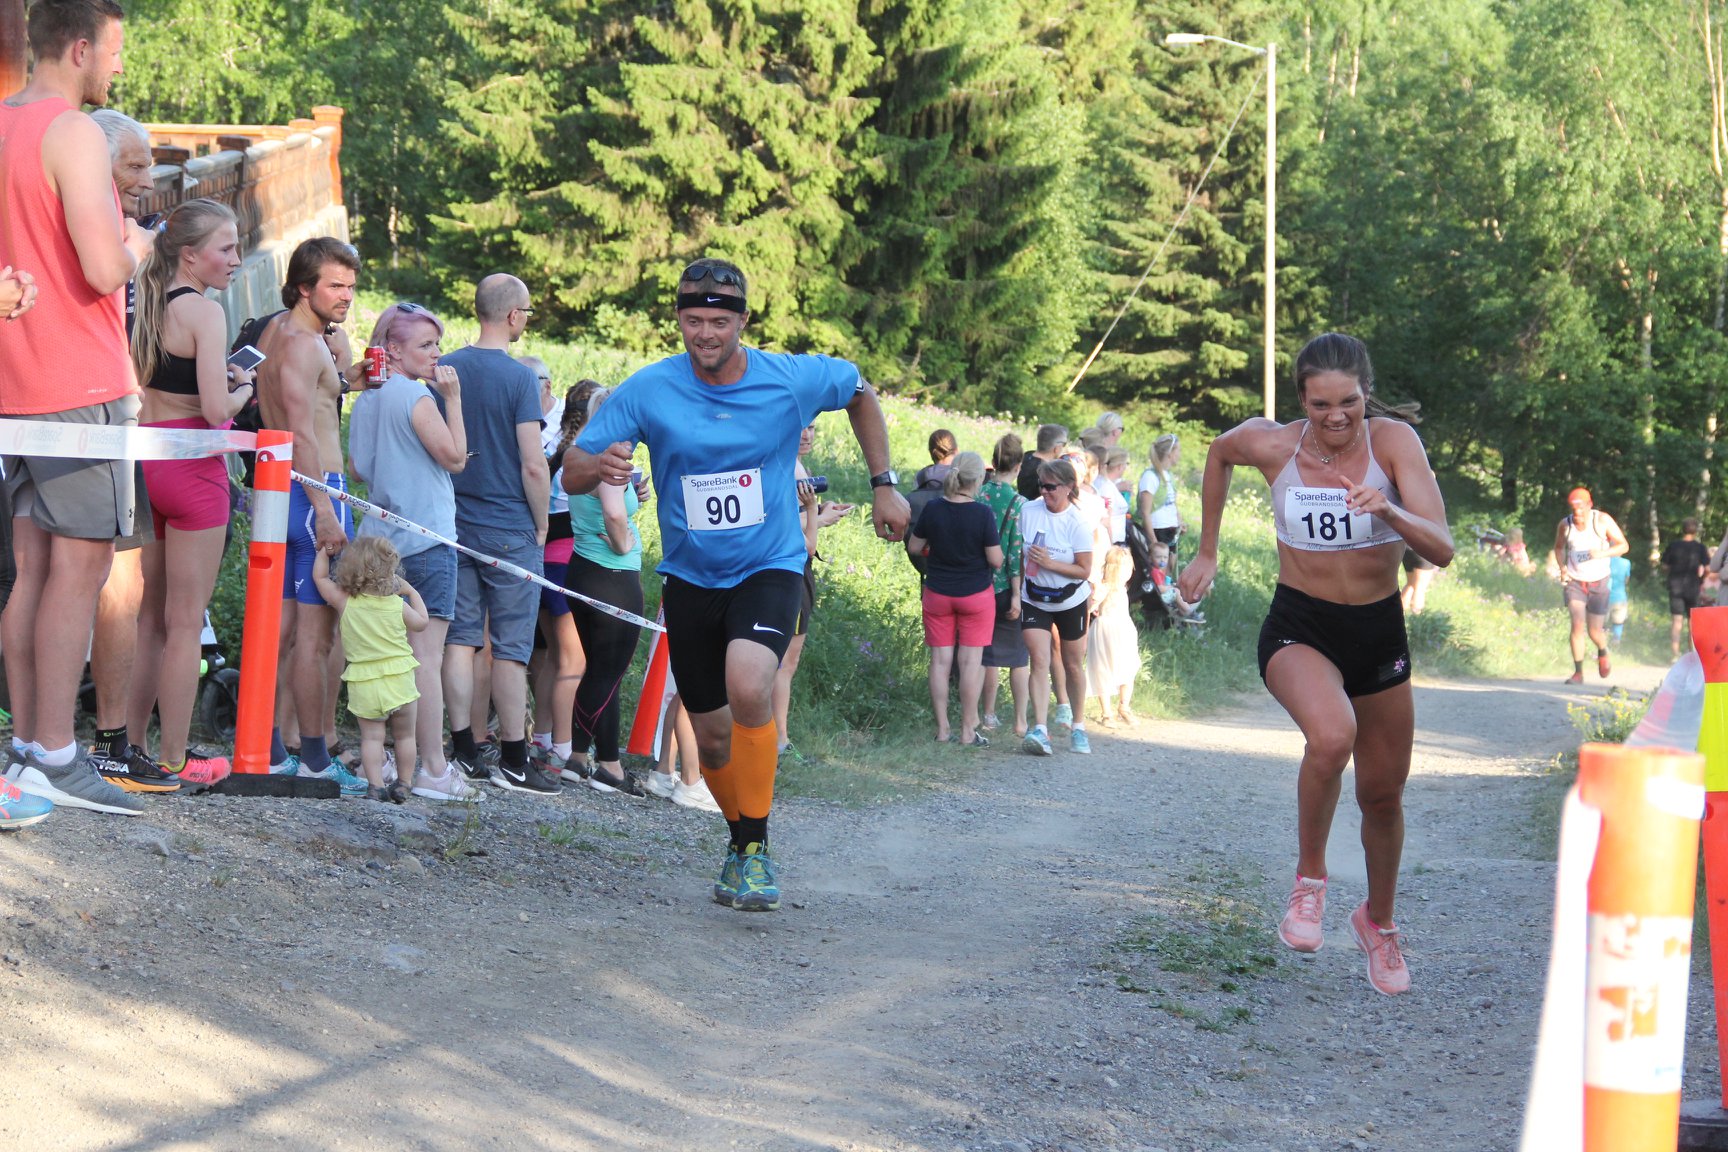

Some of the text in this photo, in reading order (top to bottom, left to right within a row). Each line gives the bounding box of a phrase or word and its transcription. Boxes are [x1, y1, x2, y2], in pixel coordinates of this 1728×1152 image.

[690, 476, 737, 488] SpareBank
[1294, 491, 1344, 502] SpareBank
[706, 494, 741, 525] 90
[1301, 512, 1352, 541] 181
